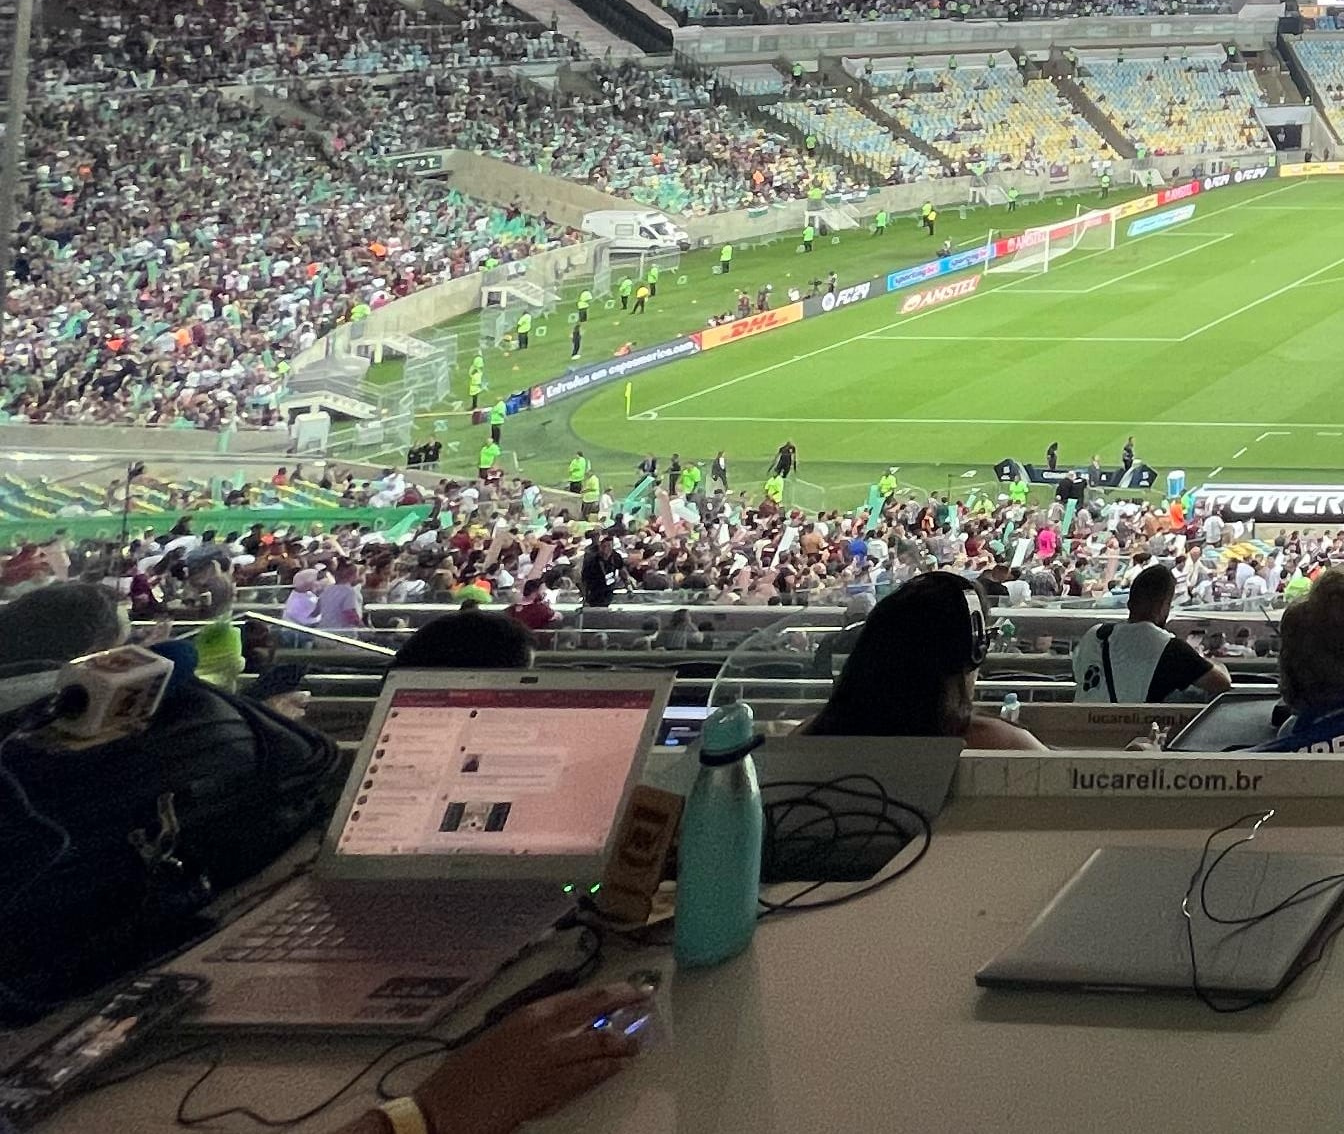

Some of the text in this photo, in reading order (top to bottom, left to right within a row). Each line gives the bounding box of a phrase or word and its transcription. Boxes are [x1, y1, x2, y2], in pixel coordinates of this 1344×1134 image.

[920, 277, 977, 305] AMSTEL
[731, 312, 779, 337] DHL
[1071, 768, 1263, 792] lucareli.com.br
